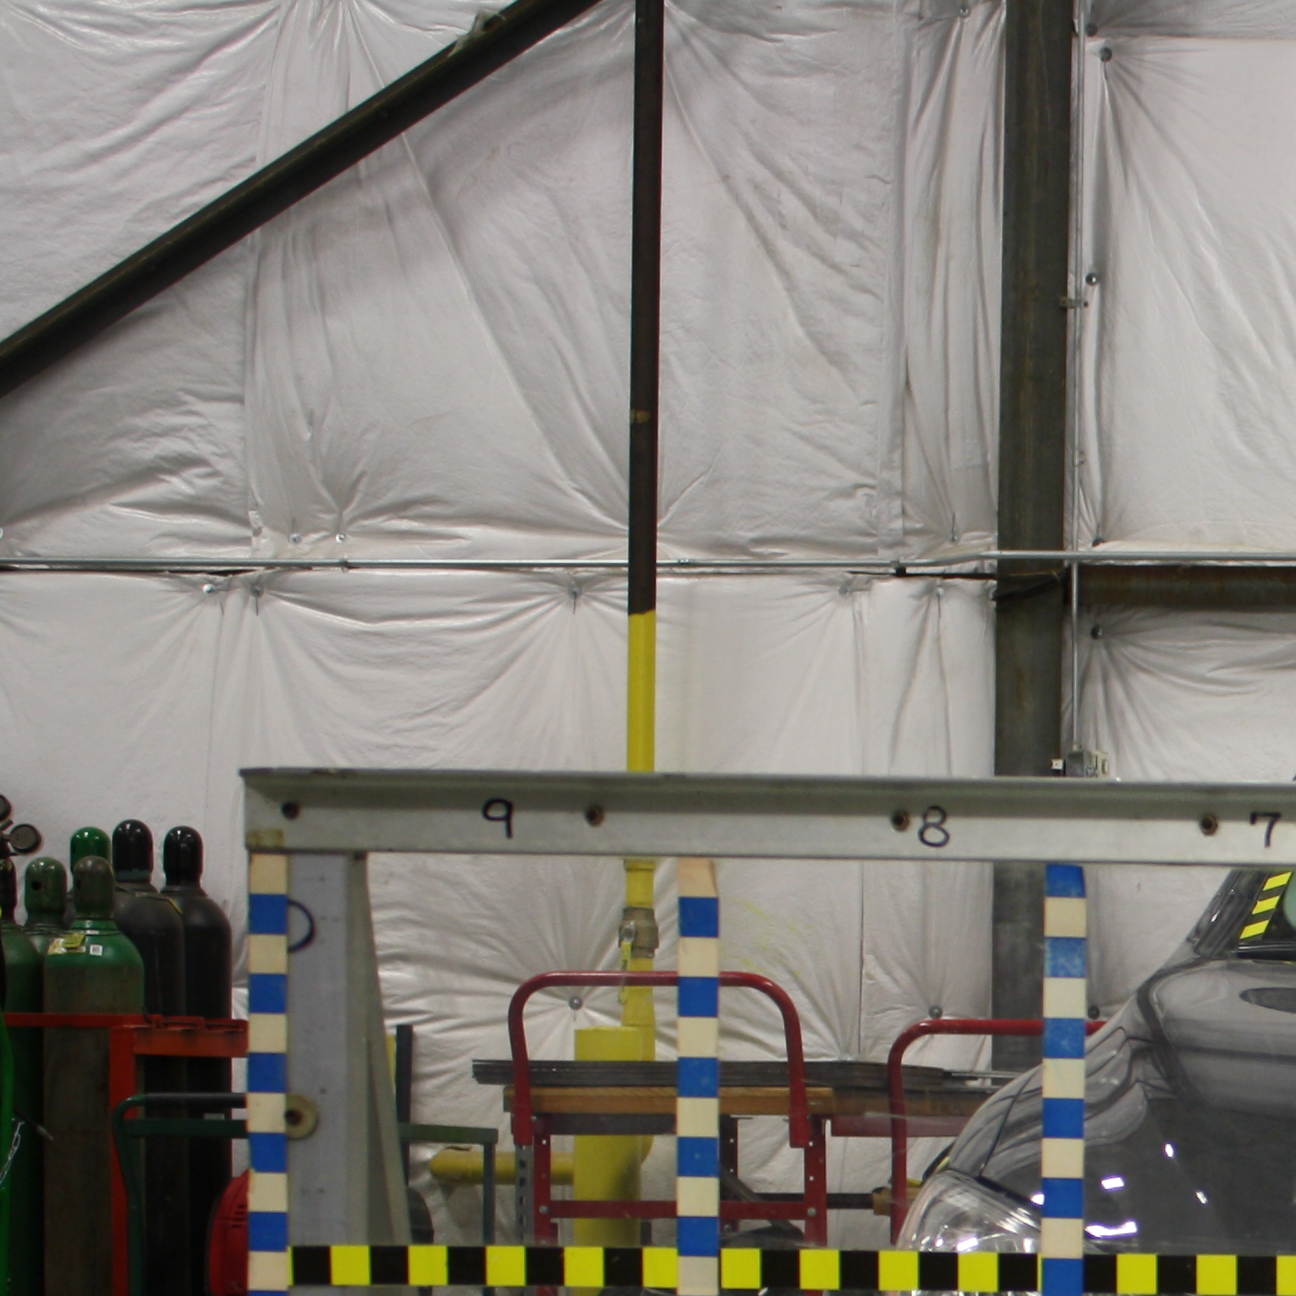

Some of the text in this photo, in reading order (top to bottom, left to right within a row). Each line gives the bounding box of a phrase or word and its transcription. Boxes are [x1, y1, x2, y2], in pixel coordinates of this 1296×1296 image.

[482, 799, 513, 838] 9
[917, 806, 950, 846] 8
[1249, 811, 1281, 848] 7
